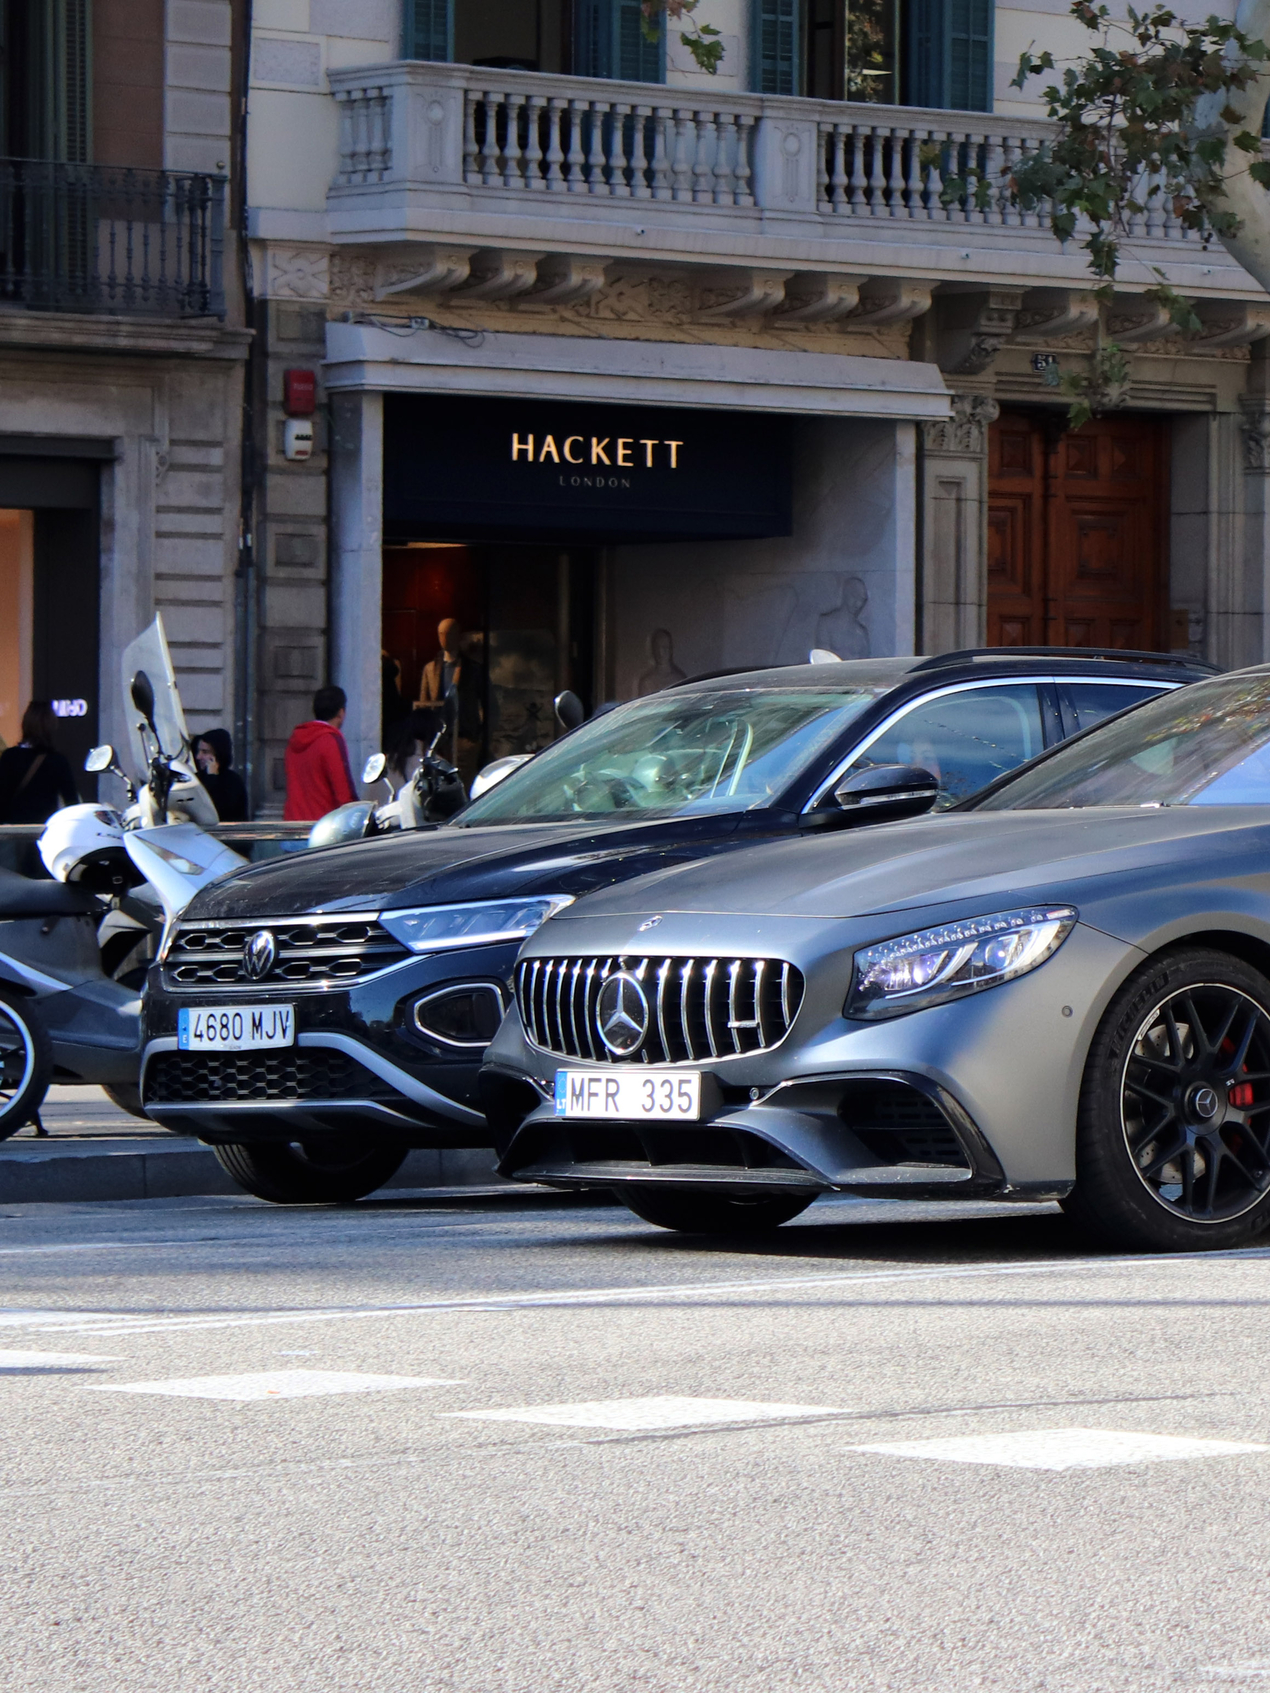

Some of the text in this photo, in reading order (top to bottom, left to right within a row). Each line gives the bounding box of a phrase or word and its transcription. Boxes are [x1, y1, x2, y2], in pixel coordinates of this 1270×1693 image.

[512, 433, 684, 468] HACKETT
[559, 476, 631, 488] LONDON
[194, 1010, 290, 1042] 4680 MJV
[556, 1099, 567, 1110] LT
[571, 1078, 693, 1113] MFR 335
